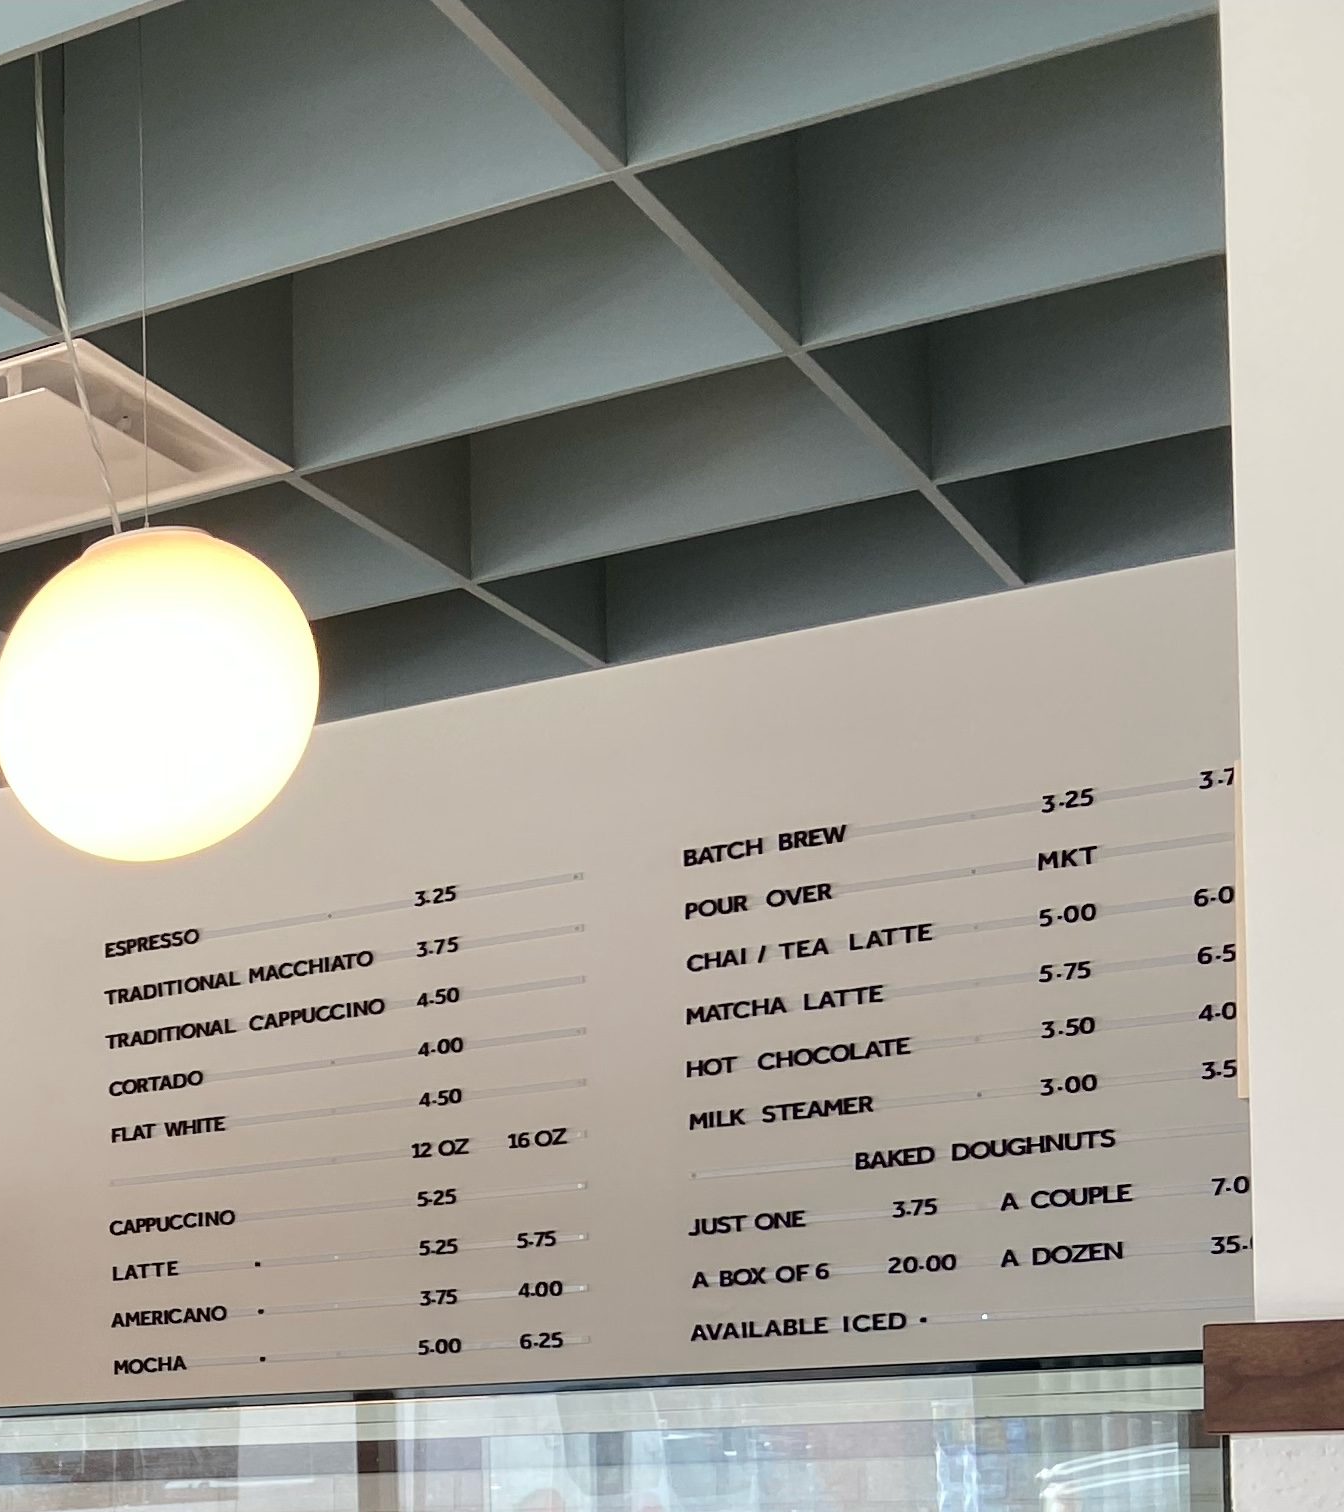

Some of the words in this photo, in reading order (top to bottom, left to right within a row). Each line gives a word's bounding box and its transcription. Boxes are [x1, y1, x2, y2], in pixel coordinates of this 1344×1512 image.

[684, 838, 764, 866] BATCH
[779, 825, 848, 851] BREW
[1042, 788, 1094, 813] 3.25
[1199, 768, 1234, 789] 3.7
[686, 896, 749, 919] POUR
[766, 884, 833, 907] OVER
[1038, 846, 1098, 871] MKT
[105, 929, 200, 958] ESPRESSO
[415, 886, 457, 906] 3.25
[687, 948, 747, 972] CHAI
[758, 946, 766, 963] /
[779, 938, 830, 959] TEA
[850, 924, 933, 950] LATTE
[1040, 904, 1097, 927] 5.00
[1194, 886, 1235, 907] 6.0
[104, 971, 241, 1005] TRADITIONAL
[248, 951, 374, 983] MACCHIATO
[417, 937, 459, 957] 3.75
[687, 997, 788, 1025] MATCHA
[804, 985, 884, 1010] LATTE
[1039, 961, 1092, 982] 5.75
[1198, 944, 1236, 964] 6.5
[105, 1019, 237, 1049] TRADITIONAL
[249, 999, 386, 1031] CAPPUCCINO
[417, 987, 460, 1007] 4.50
[687, 1056, 739, 1078] HOT
[758, 1037, 912, 1070] CHOCOLATE
[1041, 1017, 1096, 1038] 3.50
[1199, 1002, 1237, 1021] 4.0
[109, 1071, 204, 1096] CORTADO
[418, 1037, 464, 1056] 4.00
[690, 1109, 747, 1130] MILK
[762, 1096, 875, 1123] STEAMER
[1041, 1074, 1098, 1096] 3.00
[1202, 1060, 1238, 1079] 3.5
[112, 1123, 156, 1143] FLAT
[164, 1116, 227, 1137] WHITE
[419, 1089, 463, 1107] 4.50
[411, 1142, 432, 1158] 12
[438, 1138, 469, 1156] OZ
[508, 1132, 530, 1148] 16
[534, 1128, 568, 1146] OZ
[856, 1147, 936, 1170] BAKED
[952, 1129, 1117, 1161] DOUGHNUTS
[110, 1210, 236, 1236] CAPPUCCINO
[417, 1189, 457, 1207] 5.25
[688, 1215, 747, 1236] JUST
[755, 1210, 806, 1230] ONE
[892, 1198, 938, 1218] 3.75
[1001, 1193, 1020, 1211] A
[1031, 1184, 1134, 1209] COUPLE
[1211, 1176, 1250, 1196] 7.0
[113, 1261, 180, 1281] LATTE
[419, 1238, 459, 1256] 5.25
[517, 1230, 557, 1248] 5.75
[692, 1272, 709, 1288] A
[720, 1267, 766, 1287] BOX
[775, 1264, 809, 1283] OF
[815, 1263, 830, 1280] 6
[888, 1254, 957, 1273] 20.00
[1001, 1249, 1020, 1267] A
[1032, 1242, 1124, 1265] DOZEN
[1211, 1235, 1253, 1254] 35.
[111, 1306, 228, 1328] AMERICANO
[420, 1289, 458, 1306] 3.75
[518, 1281, 564, 1298] 4.00
[691, 1317, 829, 1341] AVAILABLE
[843, 1313, 907, 1332] ICED
[114, 1356, 188, 1375] MOCHA
[418, 1338, 462, 1355] 5.00
[520, 1332, 564, 1349] 6.25
